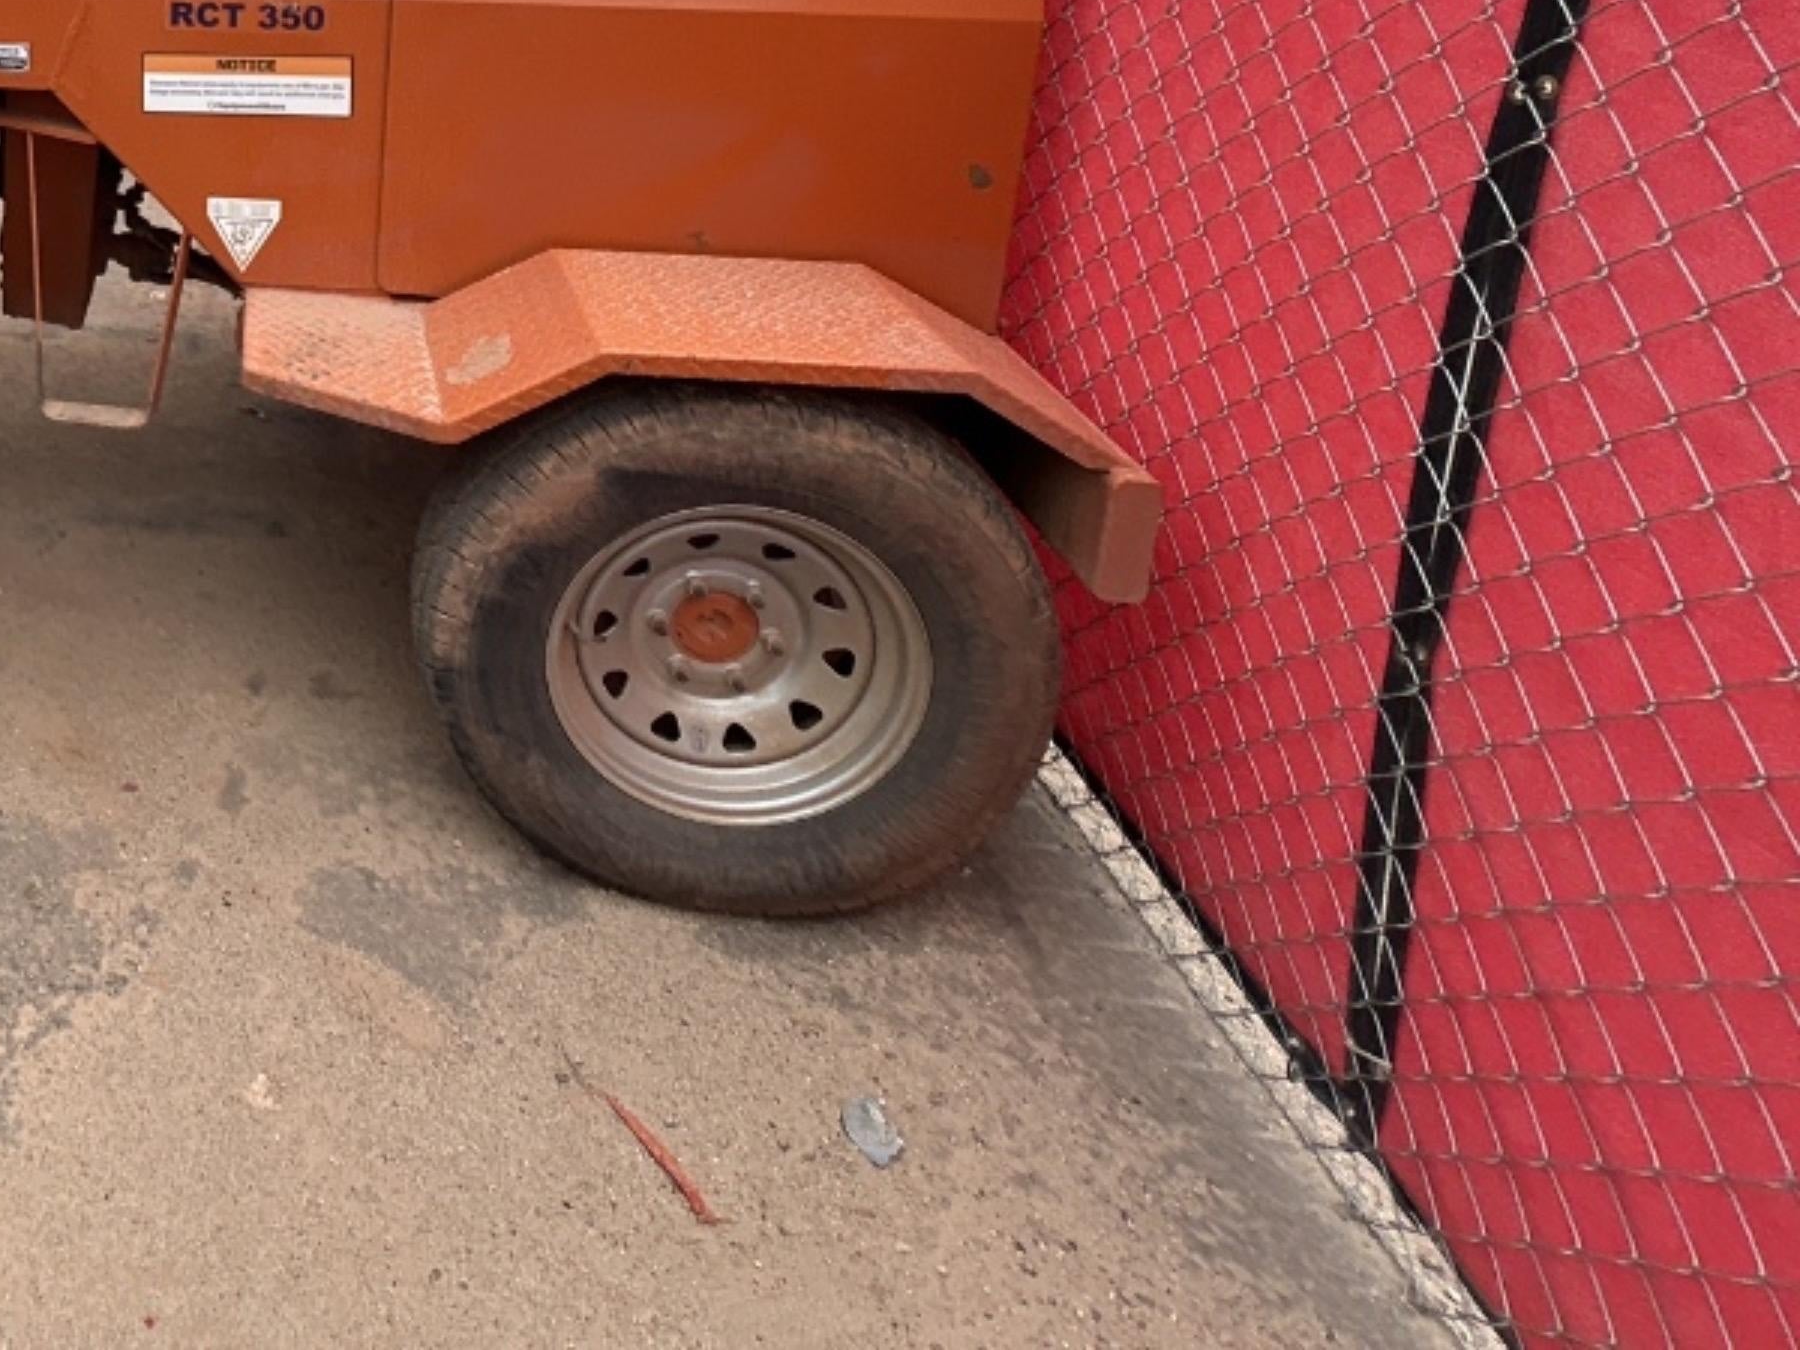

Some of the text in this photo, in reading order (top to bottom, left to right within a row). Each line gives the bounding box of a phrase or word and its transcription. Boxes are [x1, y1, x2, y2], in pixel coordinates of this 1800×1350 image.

[170, 1, 325, 31] RCT 350
[216, 59, 277, 72] NOTICE
